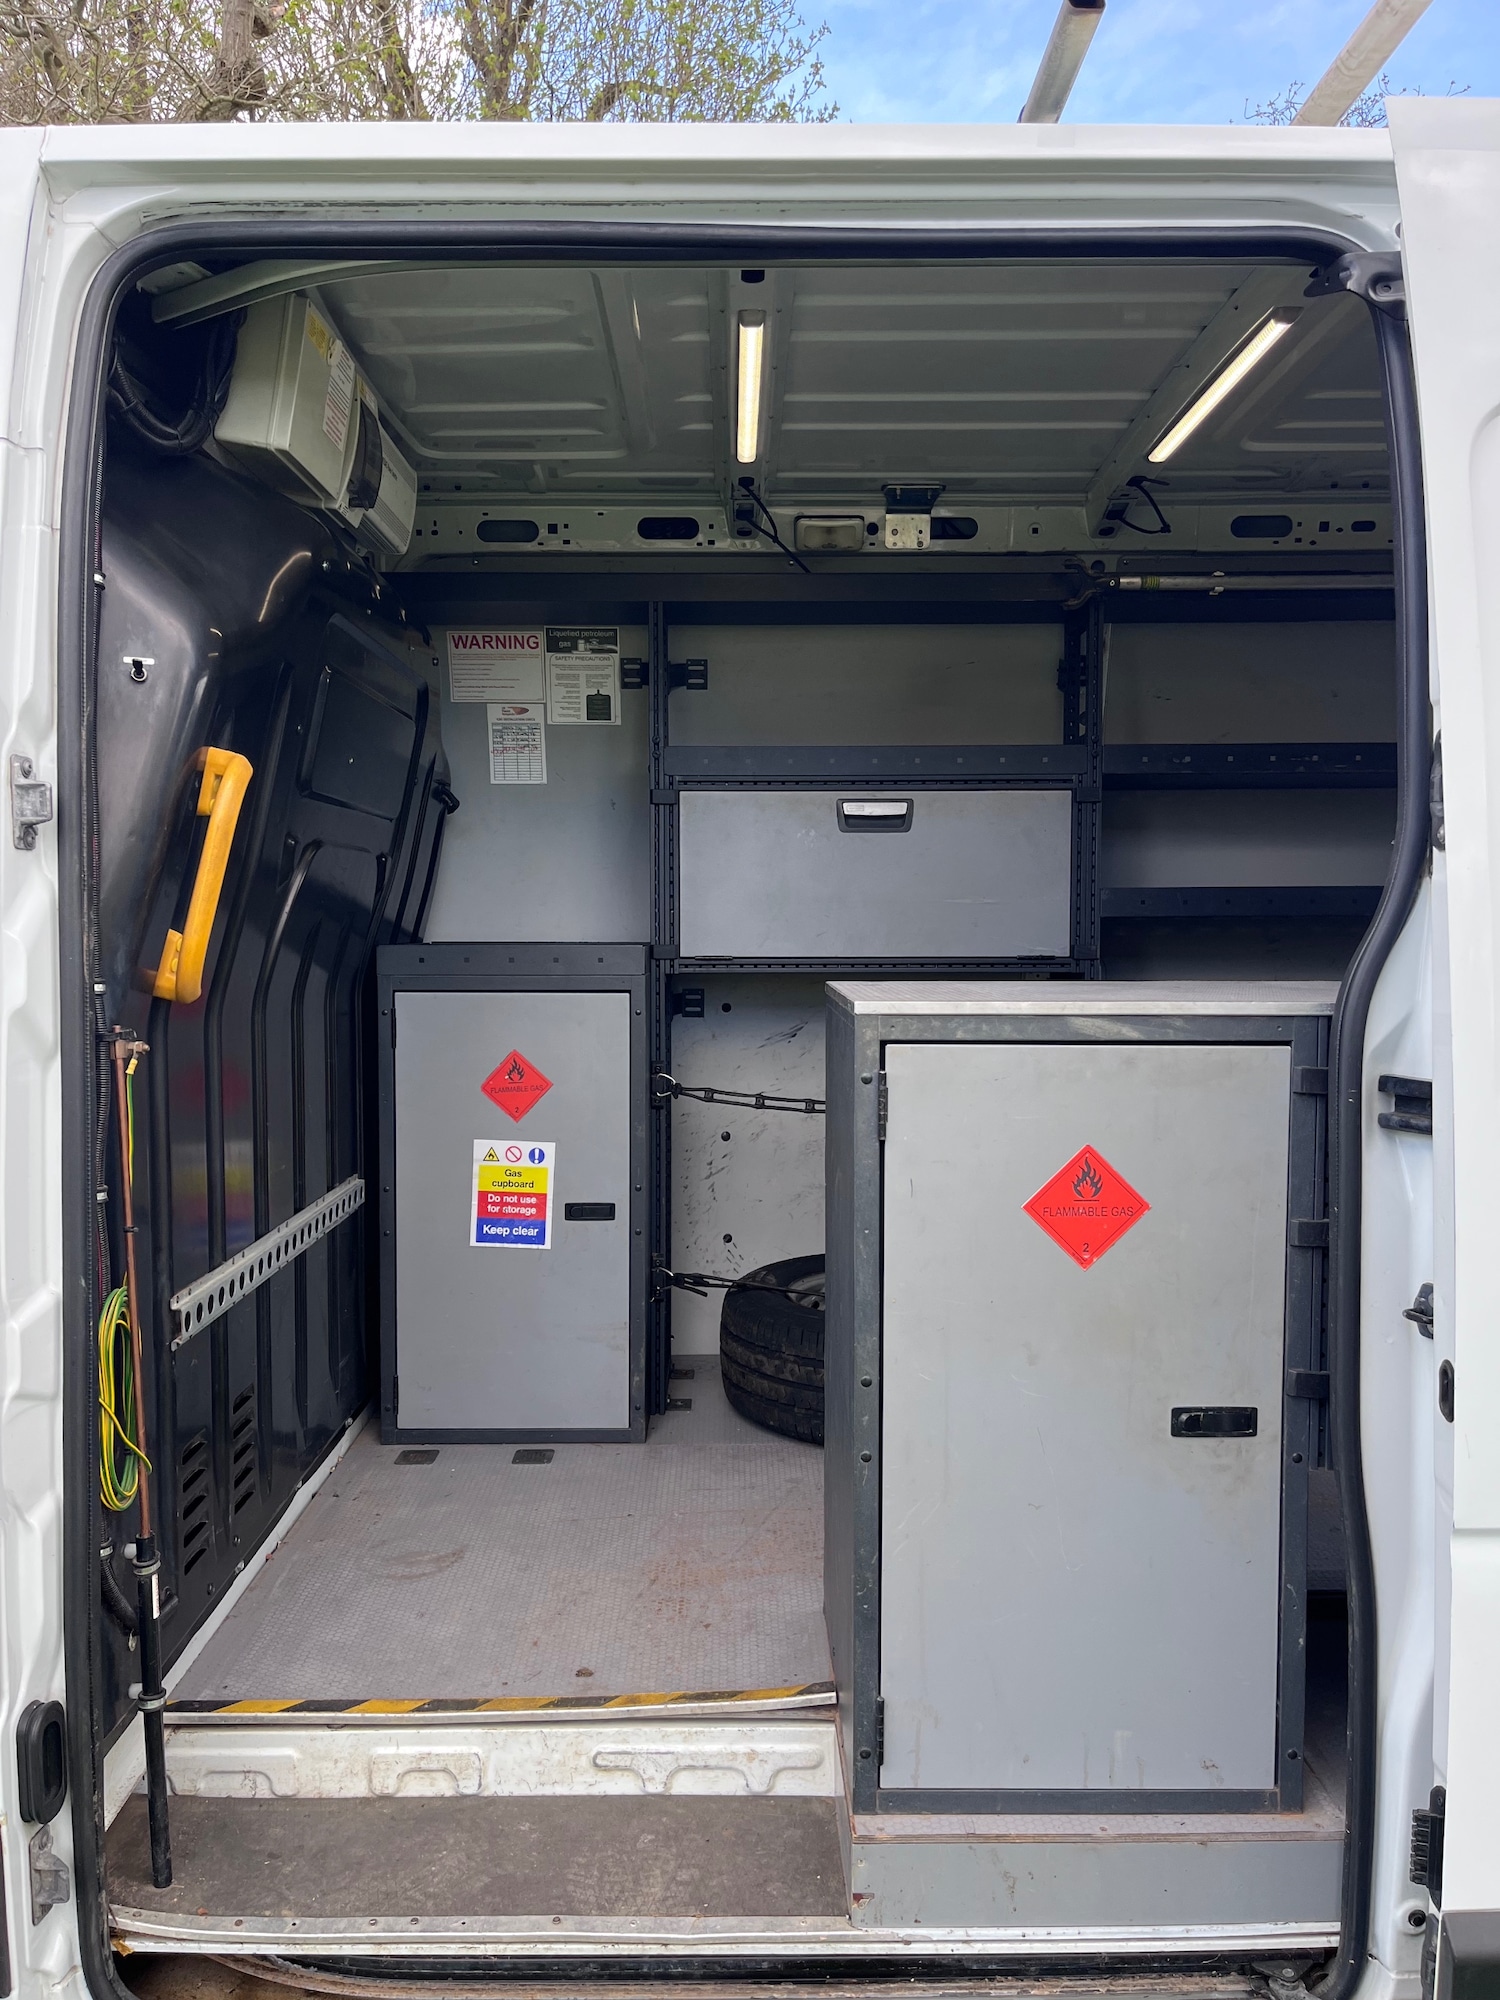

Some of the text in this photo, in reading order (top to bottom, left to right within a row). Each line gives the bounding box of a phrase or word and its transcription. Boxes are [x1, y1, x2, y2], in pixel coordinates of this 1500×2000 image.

[549, 630, 614, 638] Liquefied petroleum
[452, 635, 539, 650] WARNING
[490, 1086, 528, 1094] FLAMMABLE
[504, 1169, 522, 1178] Gas
[491, 1180, 534, 1189] cupboard
[487, 1193, 537, 1204] Do not use
[487, 1204, 537, 1216] for storage
[1042, 1206, 1134, 1217] FLAMMABLE GAS
[483, 1225, 539, 1237] Keep clear
[1082, 1242, 1090, 1253] 2
